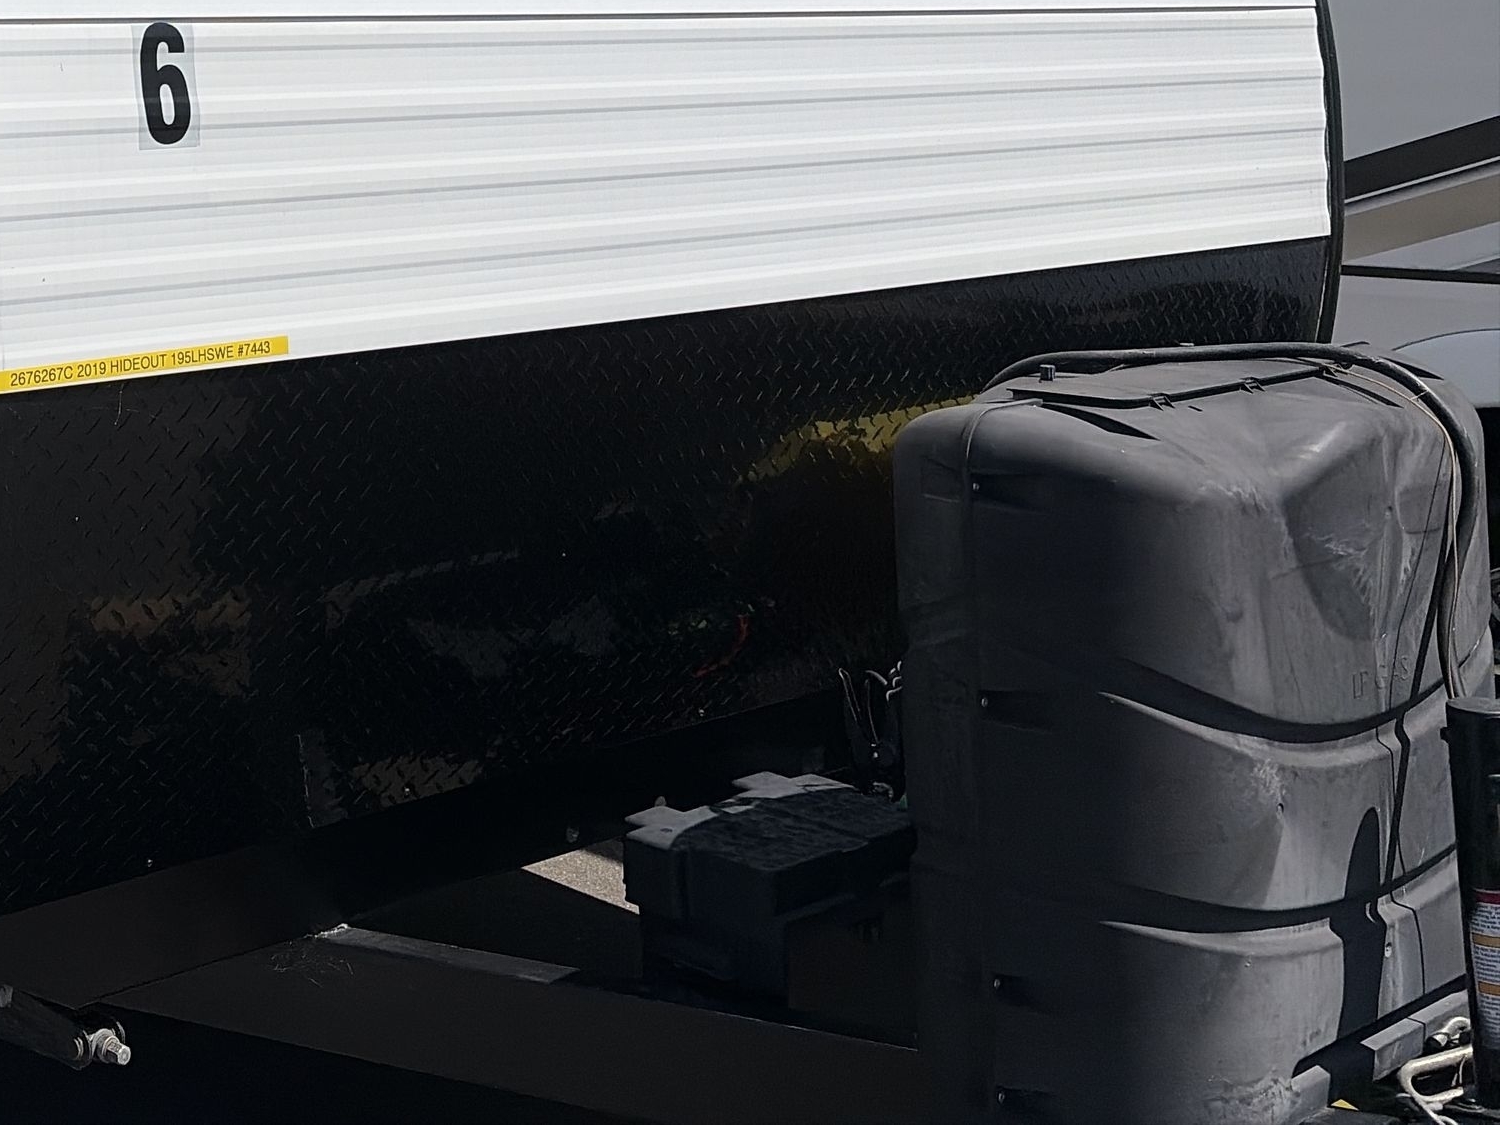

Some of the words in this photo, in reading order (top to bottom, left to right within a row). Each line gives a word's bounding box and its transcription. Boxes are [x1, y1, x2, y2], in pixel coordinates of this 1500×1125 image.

[140, 22, 191, 145] 6
[10, 365, 74, 387] 2676267C
[77, 361, 107, 378] 2019
[110, 353, 167, 374] HIDEOUT
[171, 345, 234, 366] 195LHSWE
[237, 340, 271, 357] #7443
